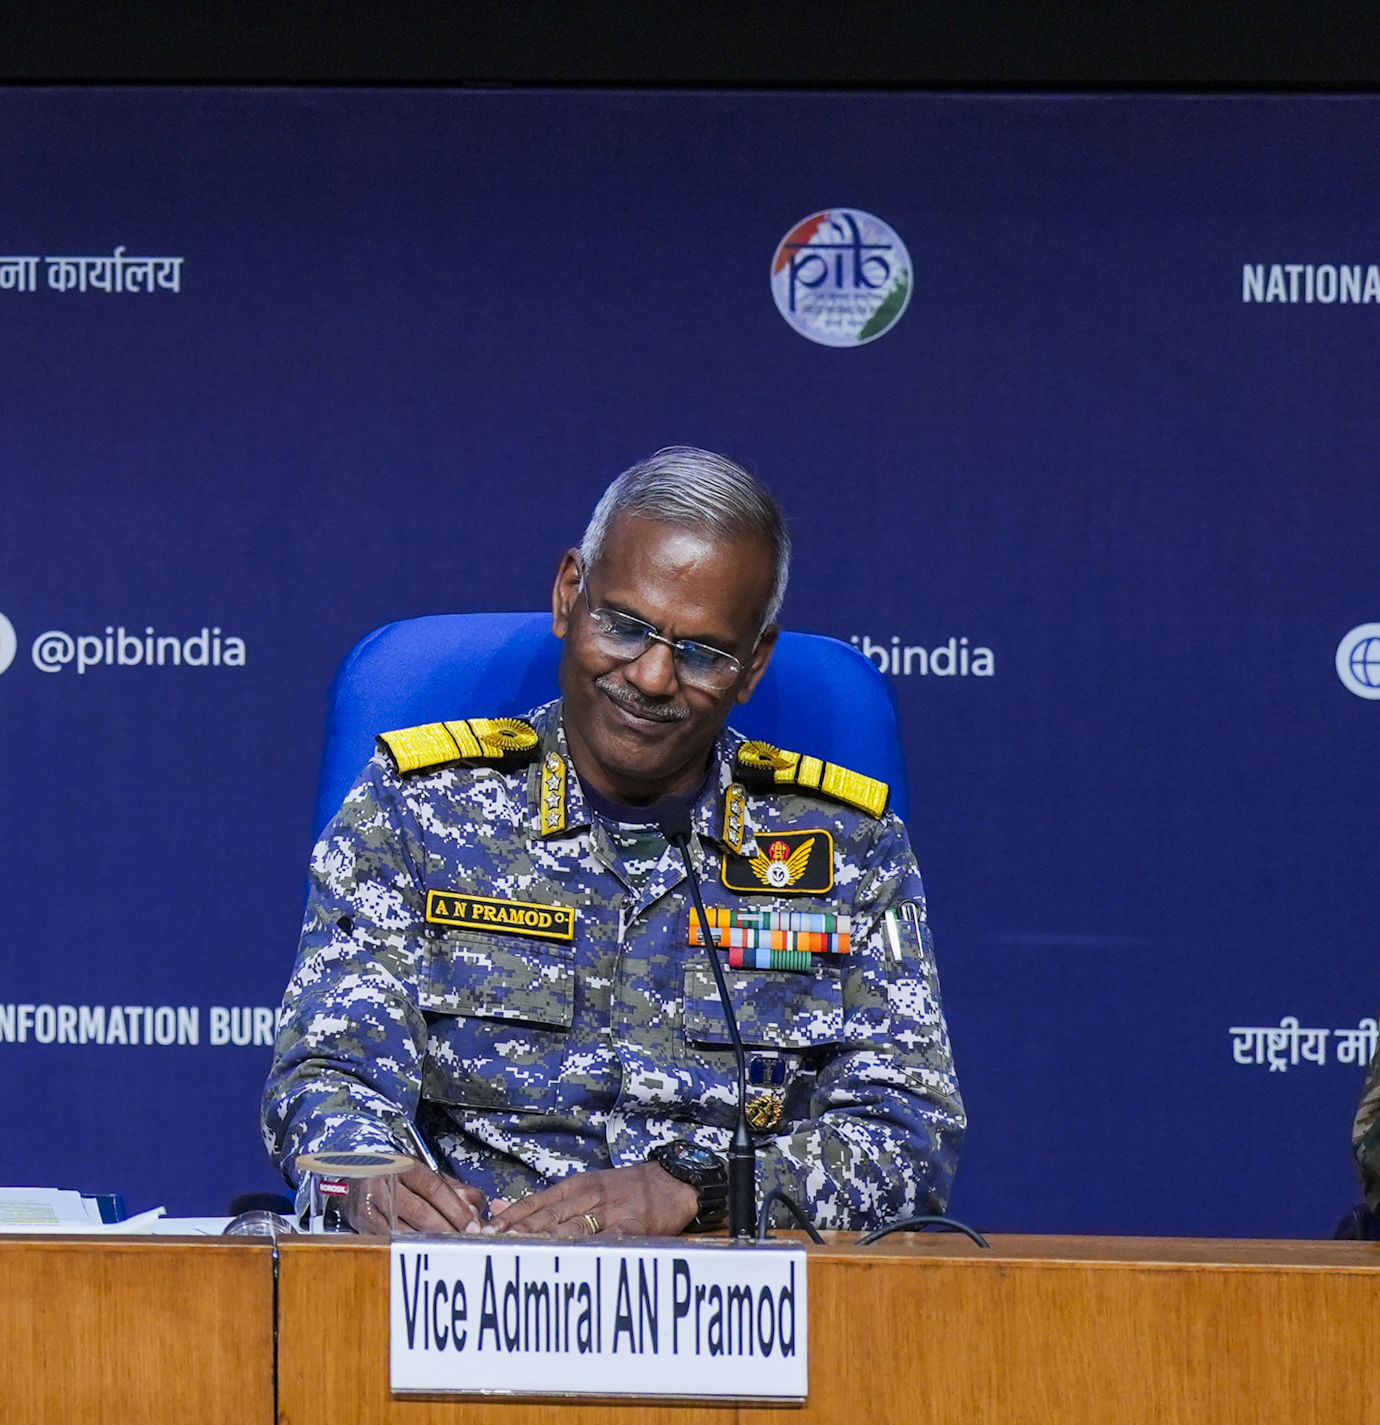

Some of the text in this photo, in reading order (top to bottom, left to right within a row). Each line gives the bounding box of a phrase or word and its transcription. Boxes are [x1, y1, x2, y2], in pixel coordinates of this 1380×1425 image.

[45, 245, 184, 293] कार्यालय
[1242, 263, 1380, 304] NATIONA
[31, 626, 246, 674] @pibindia
[849, 635, 994, 677] bindia
[435, 899, 449, 916] A
[453, 901, 467, 917] N
[471, 903, 553, 928] PRAMOD
[1229, 1016, 1331, 1072] राष्ट्रीय
[399, 1253, 796, 1359] Vice Admiral AN Pramod
